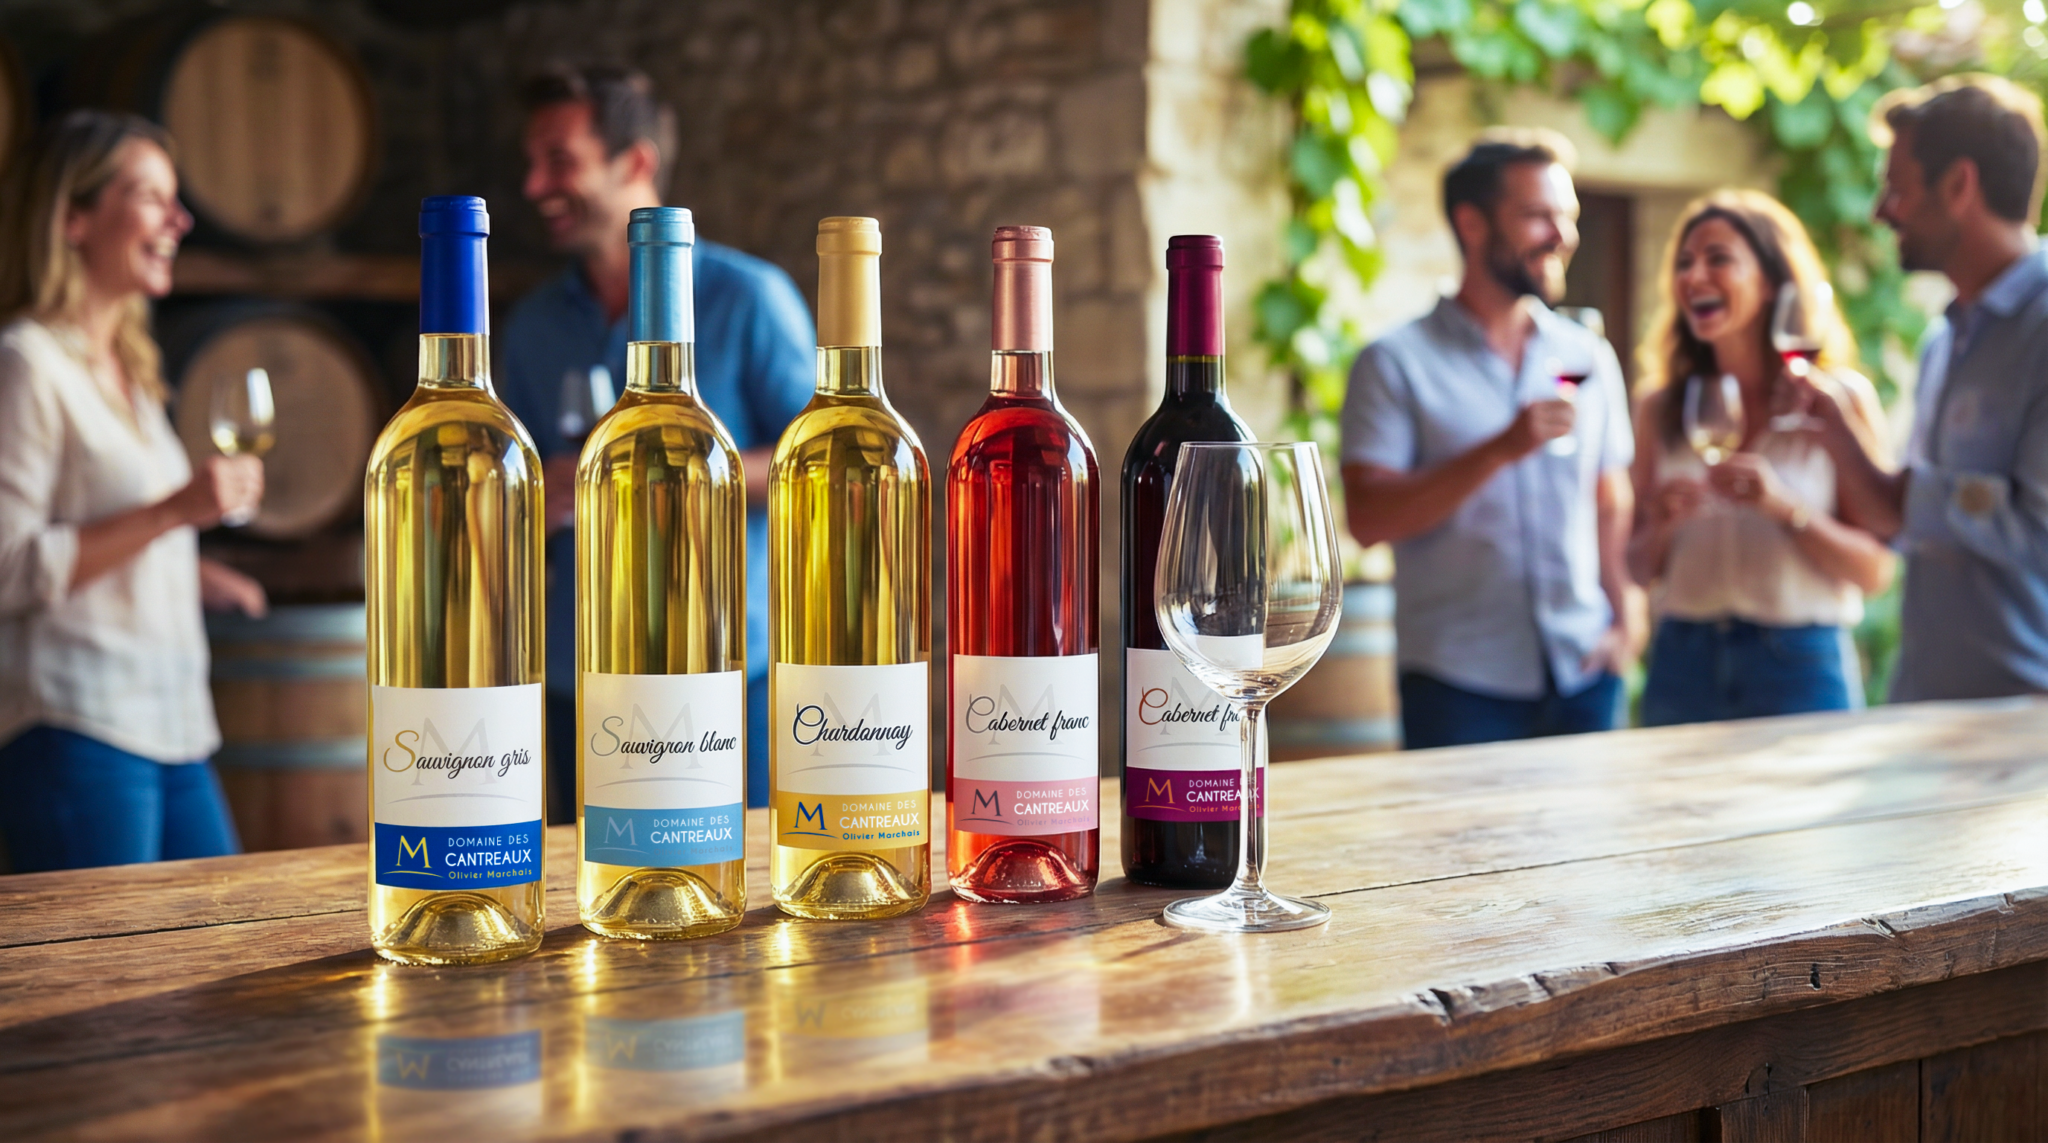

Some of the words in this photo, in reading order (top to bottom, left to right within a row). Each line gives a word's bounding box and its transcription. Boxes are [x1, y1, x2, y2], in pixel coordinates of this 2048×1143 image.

[1138, 686, 1220, 725] Cabernet
[965, 693, 1049, 734] Cabernet
[1049, 710, 1089, 741] franc
[793, 703, 913, 750] Chardonnay
[591, 716, 695, 764] Sauvignon
[699, 730, 737, 752] blanc
[383, 729, 495, 779] Sauvignon
[497, 748, 531, 777] gris
[1144, 777, 1176, 804] M
[1189, 778, 1235, 788] DOMAINE
[1016, 789, 1063, 799] DOMAINE
[1069, 787, 1087, 796] DES
[842, 802, 892, 812] DOMAINE
[897, 799, 917, 809] DES
[970, 788, 1003, 816] M
[1014, 799, 1090, 815] CANTREAUX
[1189, 805, 1218, 813] Olivier
[653, 817, 704, 828] DOMAINE
[710, 815, 730, 825] DES
[793, 801, 828, 830] M
[839, 812, 920, 829] CANTREAUX
[1016, 818, 1047, 826] Olivier
[1050, 816, 1090, 825] Marchais
[448, 836, 502, 847] DOMAINE
[508, 834, 529, 845] DES
[650, 827, 733, 844] CANTREAUX
[842, 832, 874, 840] Olivier
[878, 829, 920, 839] Marchais
[395, 835, 432, 868] M
[445, 849, 532, 867] CANTREAUX
[654, 848, 686, 856] Olivier
[690, 845, 733, 855] Marchais
[448, 871, 482, 879] Olivier
[487, 868, 532, 878] Marchais
